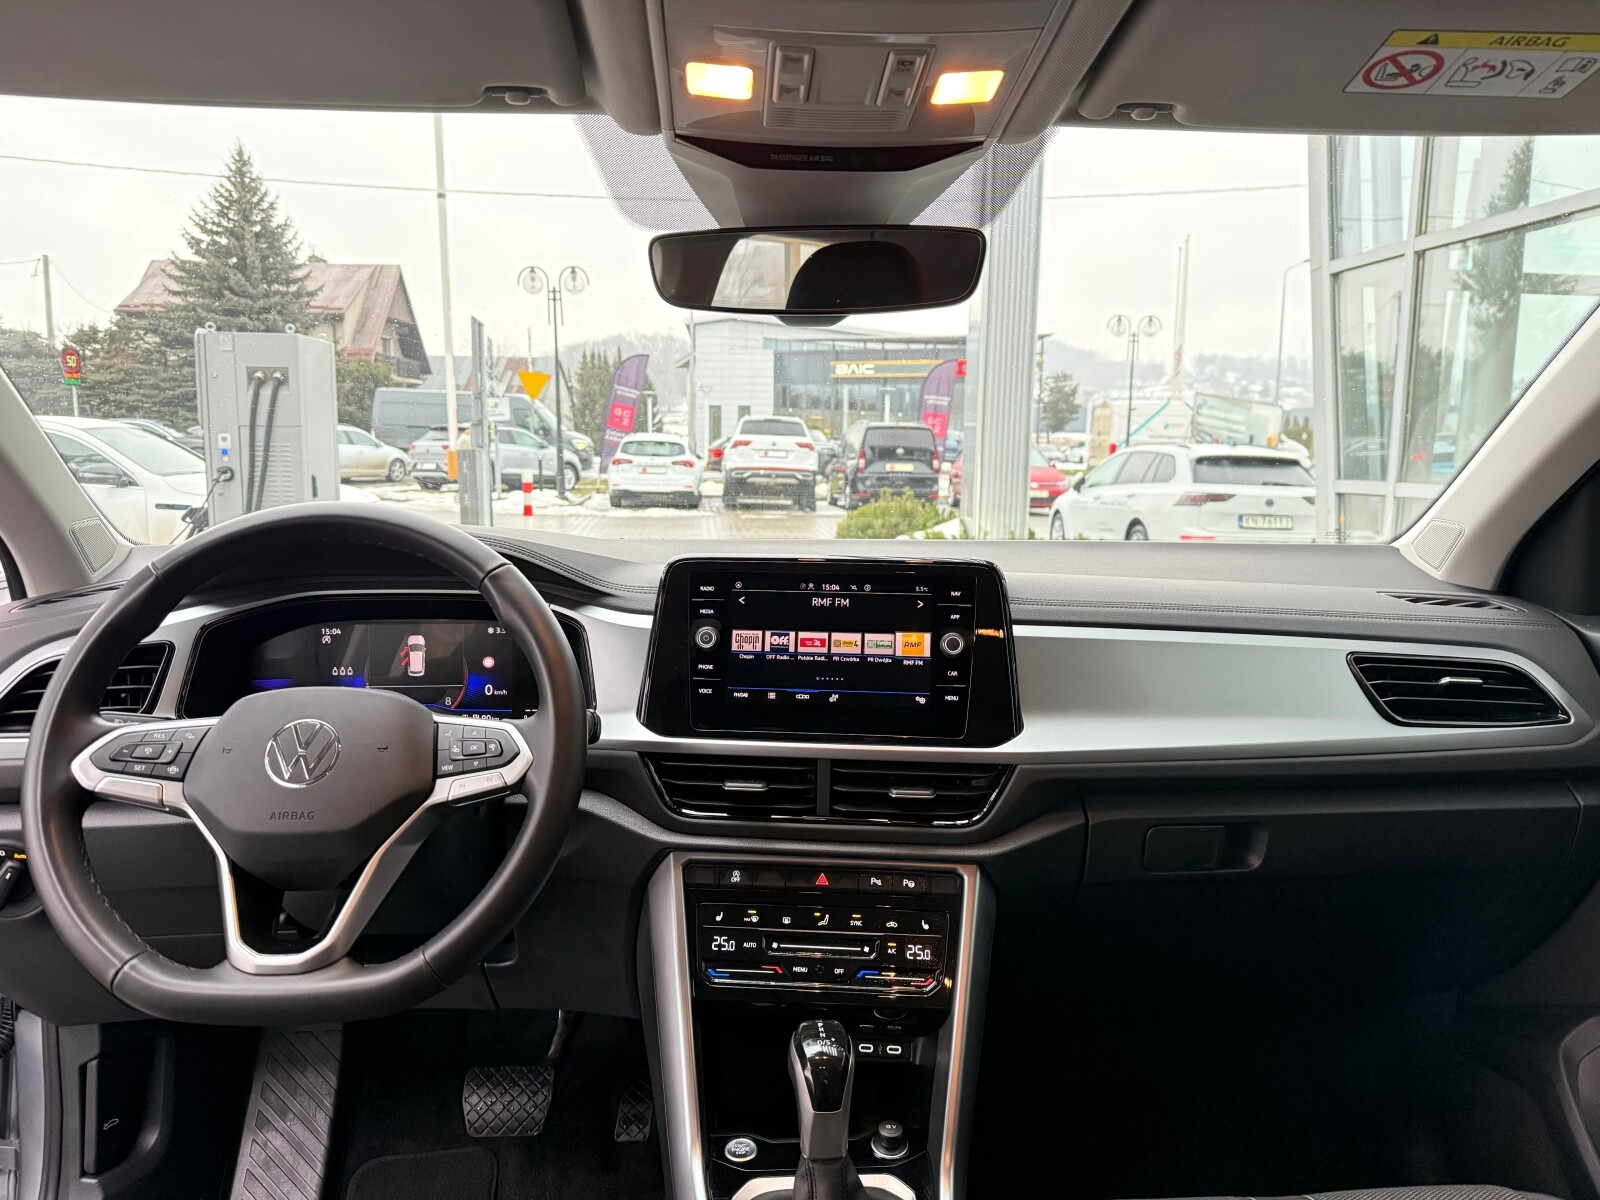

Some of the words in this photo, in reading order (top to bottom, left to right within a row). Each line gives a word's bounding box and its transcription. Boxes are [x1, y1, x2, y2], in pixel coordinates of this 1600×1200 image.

[1488, 34, 1572, 48] AIRBAG
[770, 153, 808, 161] PASSENGER
[812, 597, 832, 606] RMF
[835, 598, 849, 607] FM
[485, 684, 493, 695] 0
[445, 697, 452, 705] 8
[268, 810, 317, 822] AIRBAG
[712, 936, 735, 951] 25.0
[906, 945, 931, 960] 25.0
